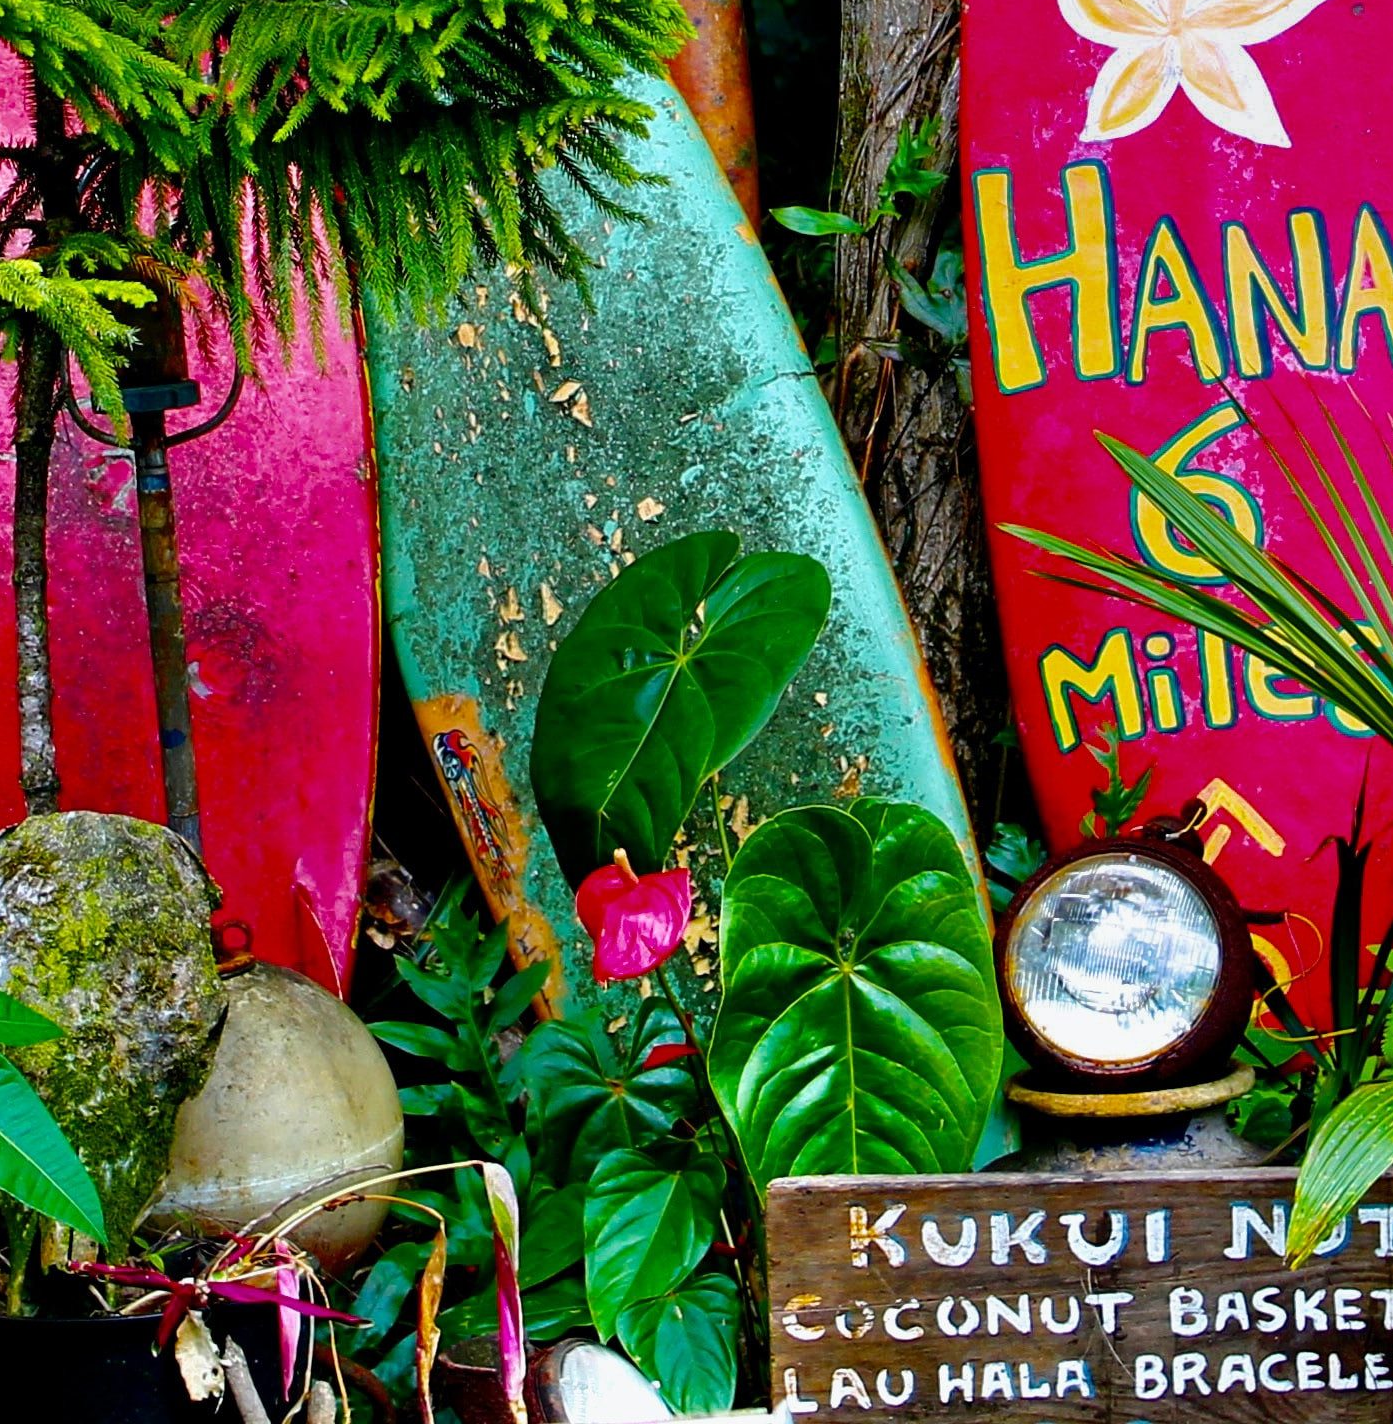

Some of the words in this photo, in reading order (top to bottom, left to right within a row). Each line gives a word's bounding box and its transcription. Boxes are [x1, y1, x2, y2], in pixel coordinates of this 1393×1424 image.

[1129, 400, 1264, 586] 6
[849, 1201, 1170, 1268] KUKUI
[782, 1291, 1134, 1342] COCONUT
[783, 1365, 911, 1414] LAU
[938, 1358, 1094, 1404] HALA
